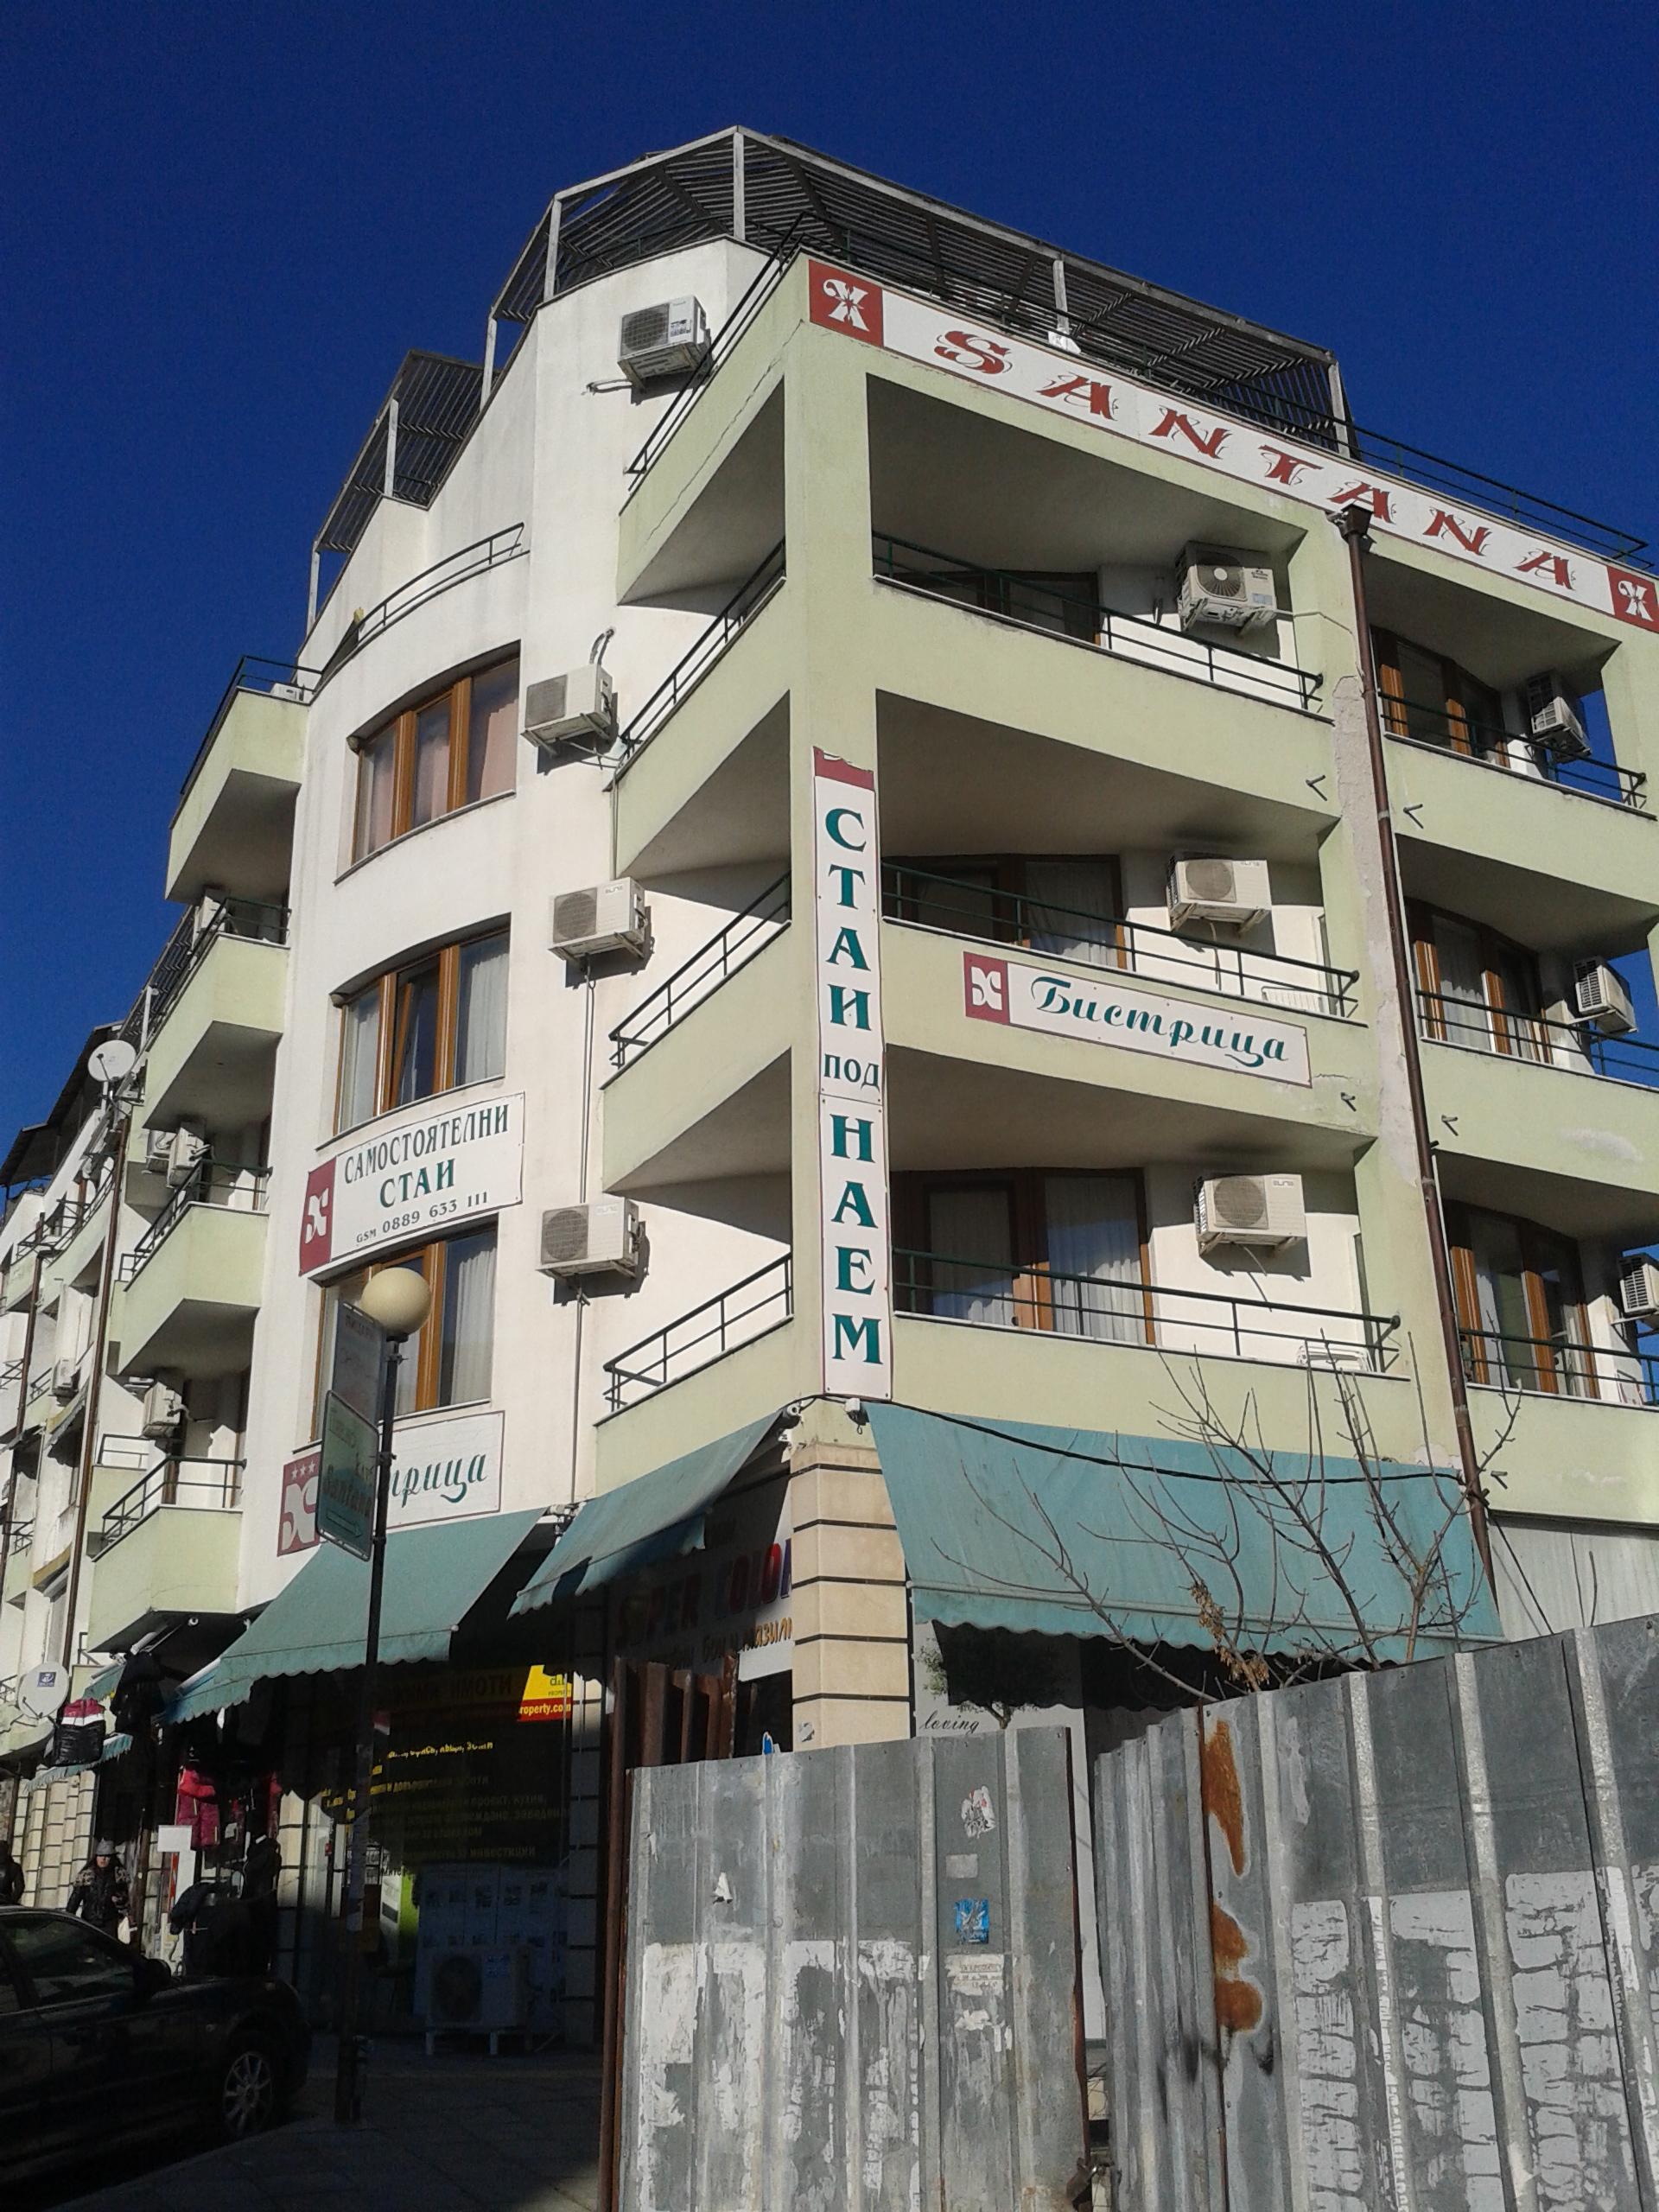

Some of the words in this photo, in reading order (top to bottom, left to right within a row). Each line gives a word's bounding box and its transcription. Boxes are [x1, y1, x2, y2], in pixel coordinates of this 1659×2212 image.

[934, 328, 1578, 592] SANTANA
[824, 807, 873, 1033] СТАИ
[1030, 976, 1289, 1068] Бистрица
[823, 1052, 880, 1090] под
[343, 1103, 510, 1185] САМОСТОЯТЕЛНИ
[378, 1158, 457, 1209] СТАИ
[355, 1228, 378, 1245] GSM
[382, 1211, 422, 1234] 0889
[429, 1198, 458, 1218] 633
[467, 1191, 489, 1208] 111
[830, 1113, 881, 1366] НАЕМ
[918, 1709, 980, 1736] loving
